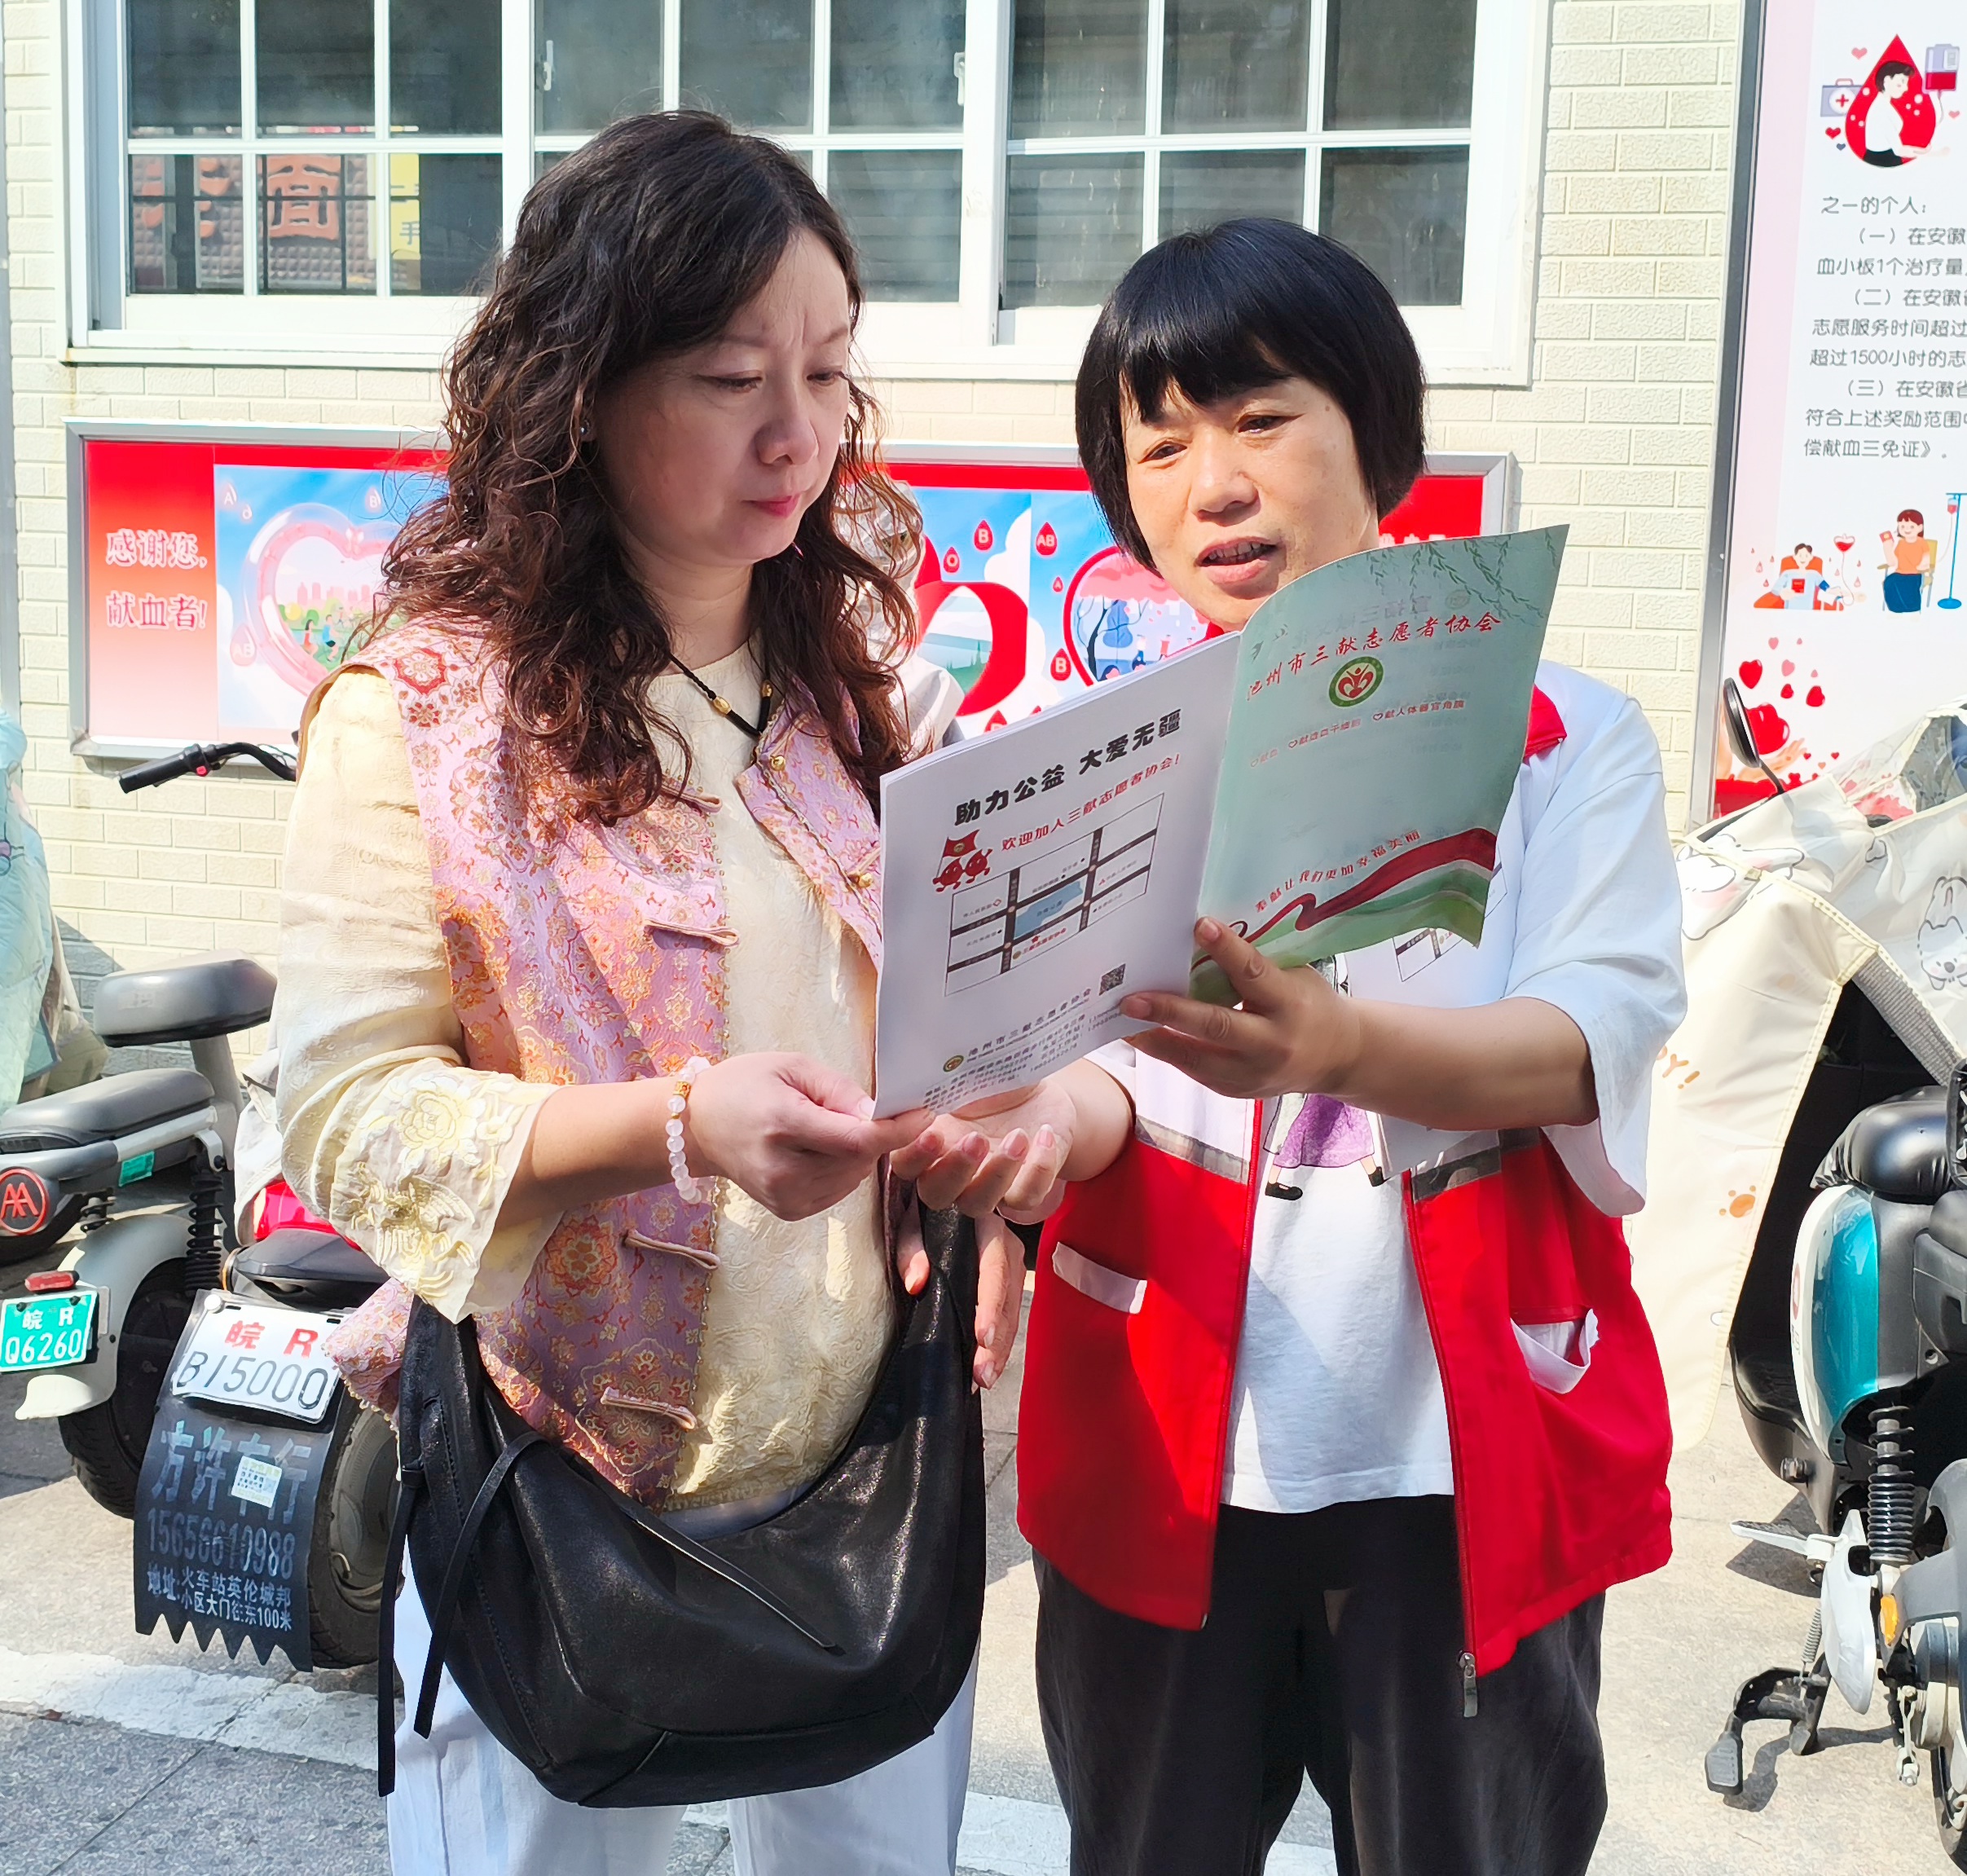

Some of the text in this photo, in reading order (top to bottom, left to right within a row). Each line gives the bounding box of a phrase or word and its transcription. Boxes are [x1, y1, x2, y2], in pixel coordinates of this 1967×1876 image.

[1855, 289, 1967, 306] （二）在安徽
[1806, 409, 1967, 428] 符合上述奖励范围
[979, 528, 989, 543] B
[1037, 535, 1055, 547] AB
[946, 554, 958, 566] O
[1055, 657, 1067, 672] B
[1247, 611, 1501, 701] 池州市三献志愿者协会
[954, 708, 1182, 826] 助力公益 大爱无疆
[22, 1307, 74, 1331] 皖 R
[5, 1328, 82, 1364] Q6260
[224, 1320, 319, 1359] 皖 R
[176, 1350, 328, 1410] B15000
